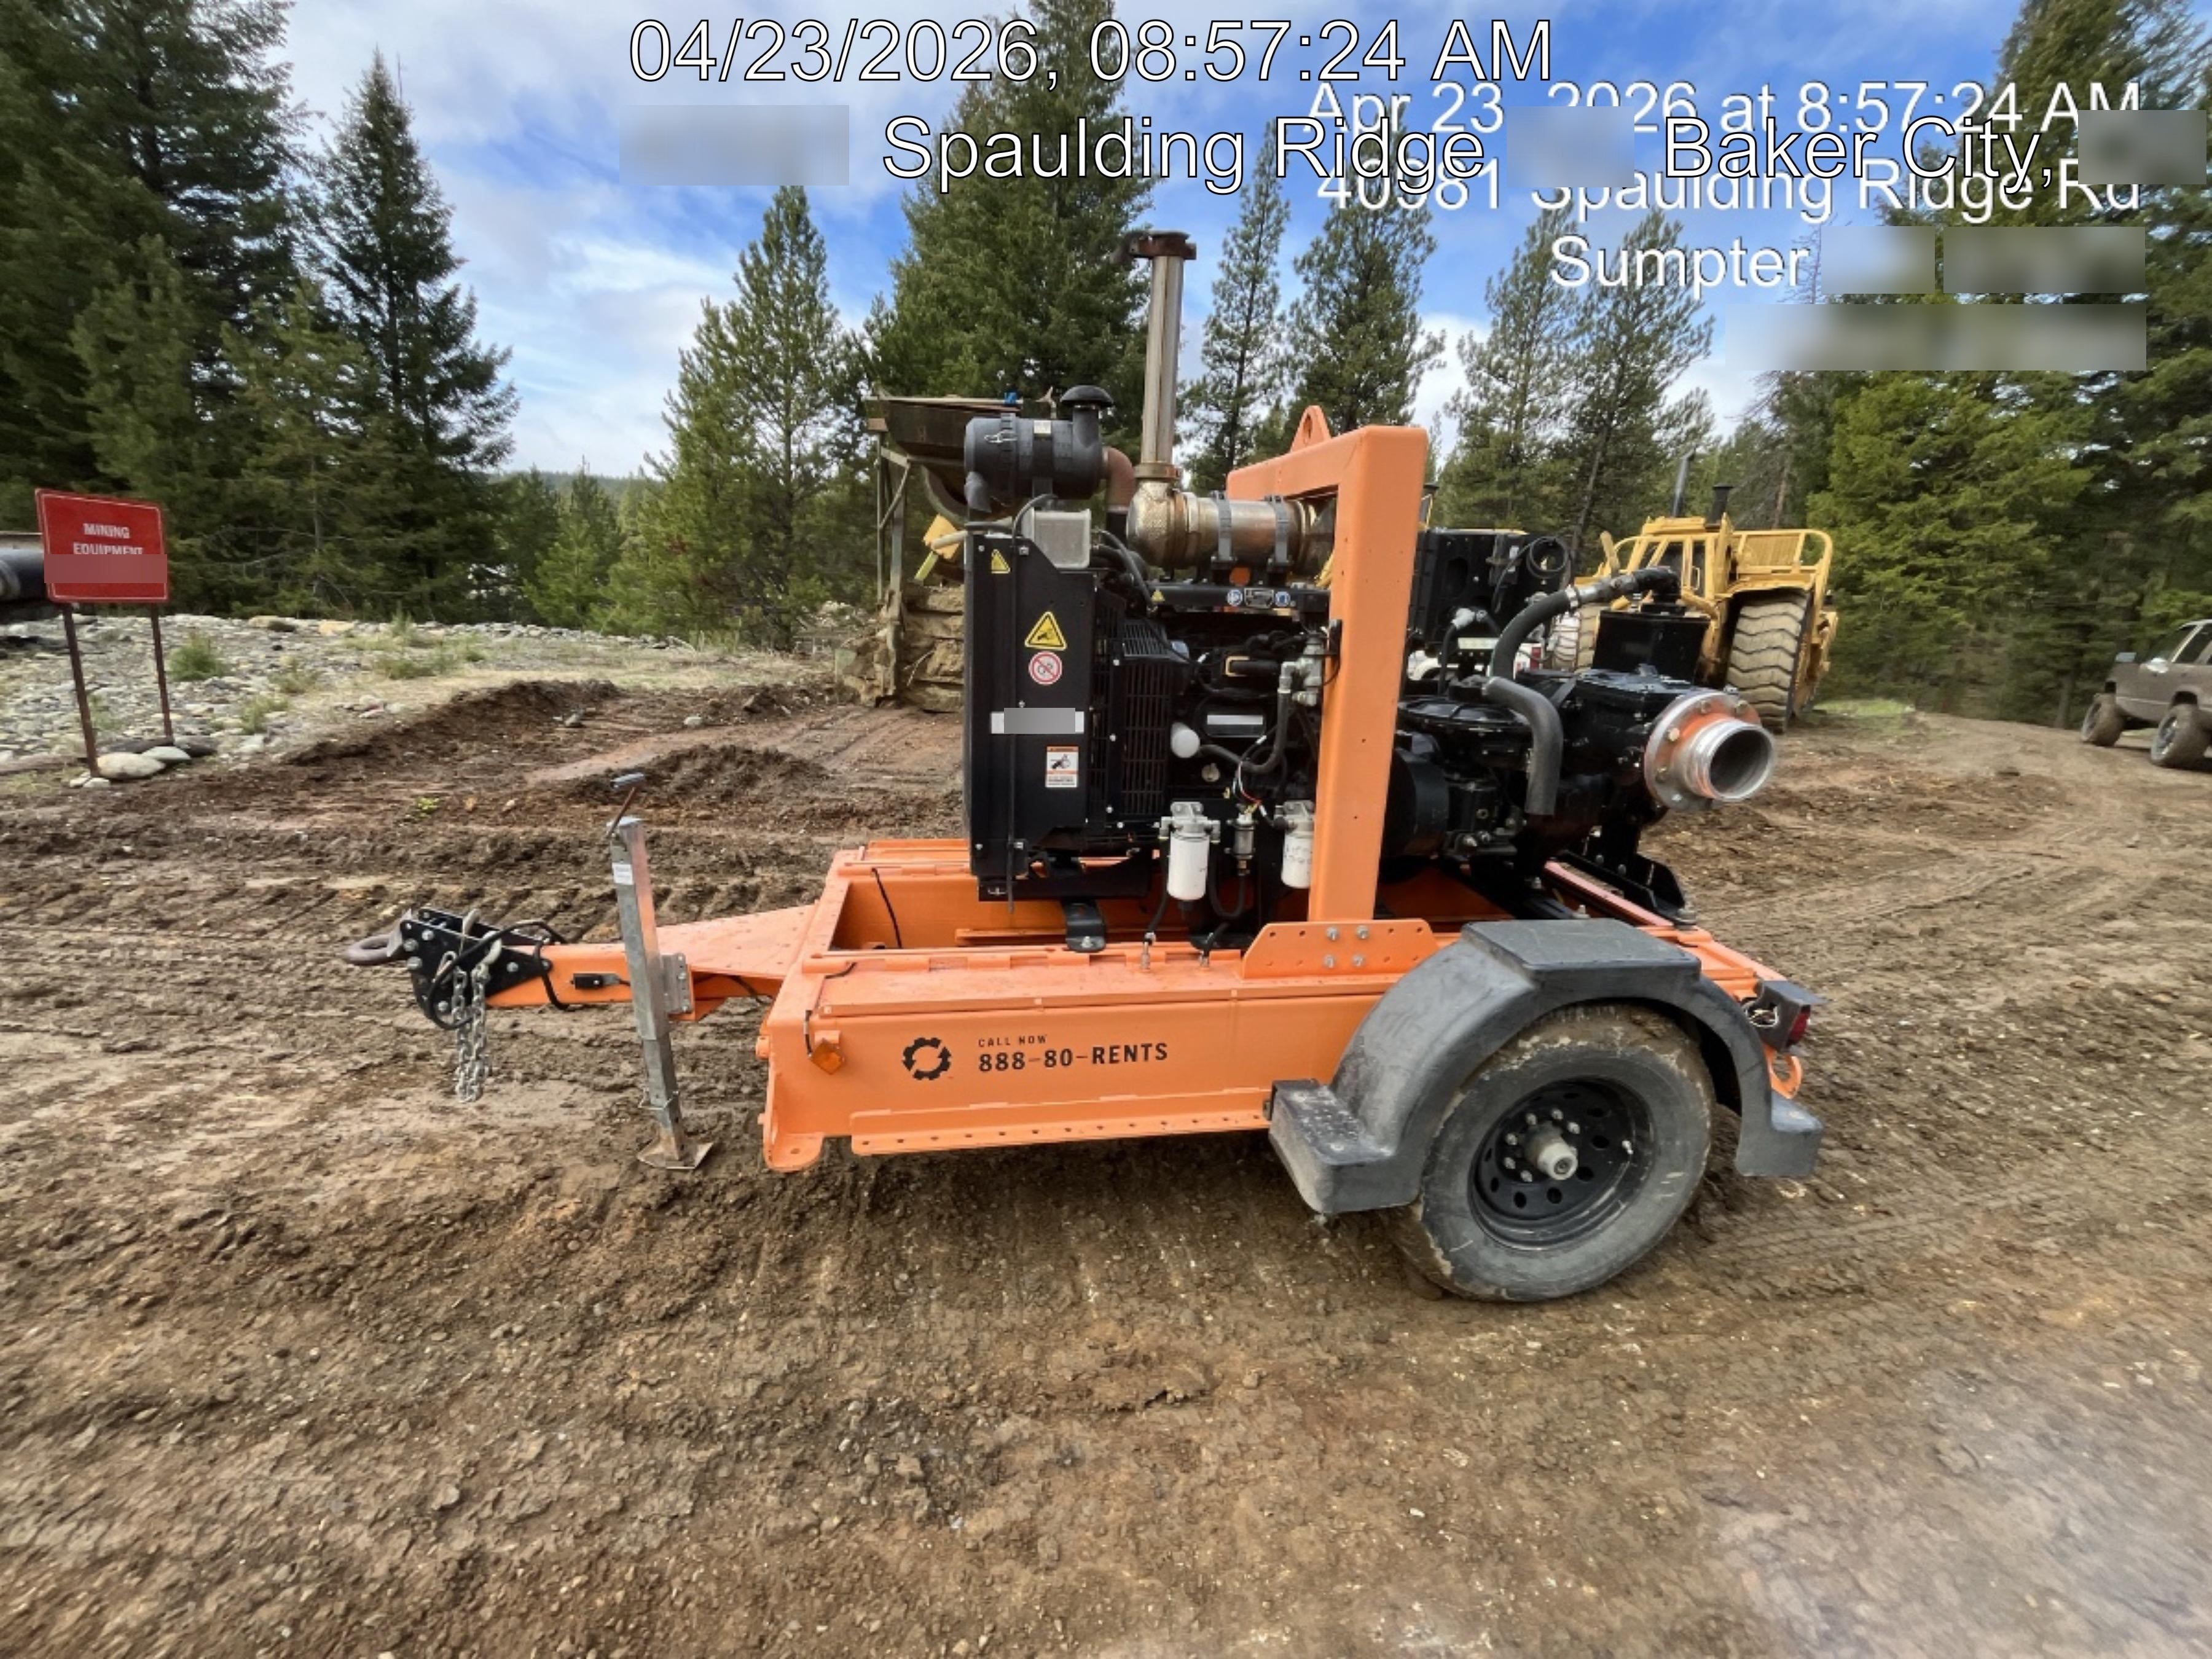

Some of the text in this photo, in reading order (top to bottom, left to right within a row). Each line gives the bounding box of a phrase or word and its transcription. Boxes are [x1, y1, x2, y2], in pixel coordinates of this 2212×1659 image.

[83, 523, 130, 539] MINING
[978, 1033, 1048, 1048] CALL NOW
[979, 1043, 1168, 1072] 888-80-RENTS
